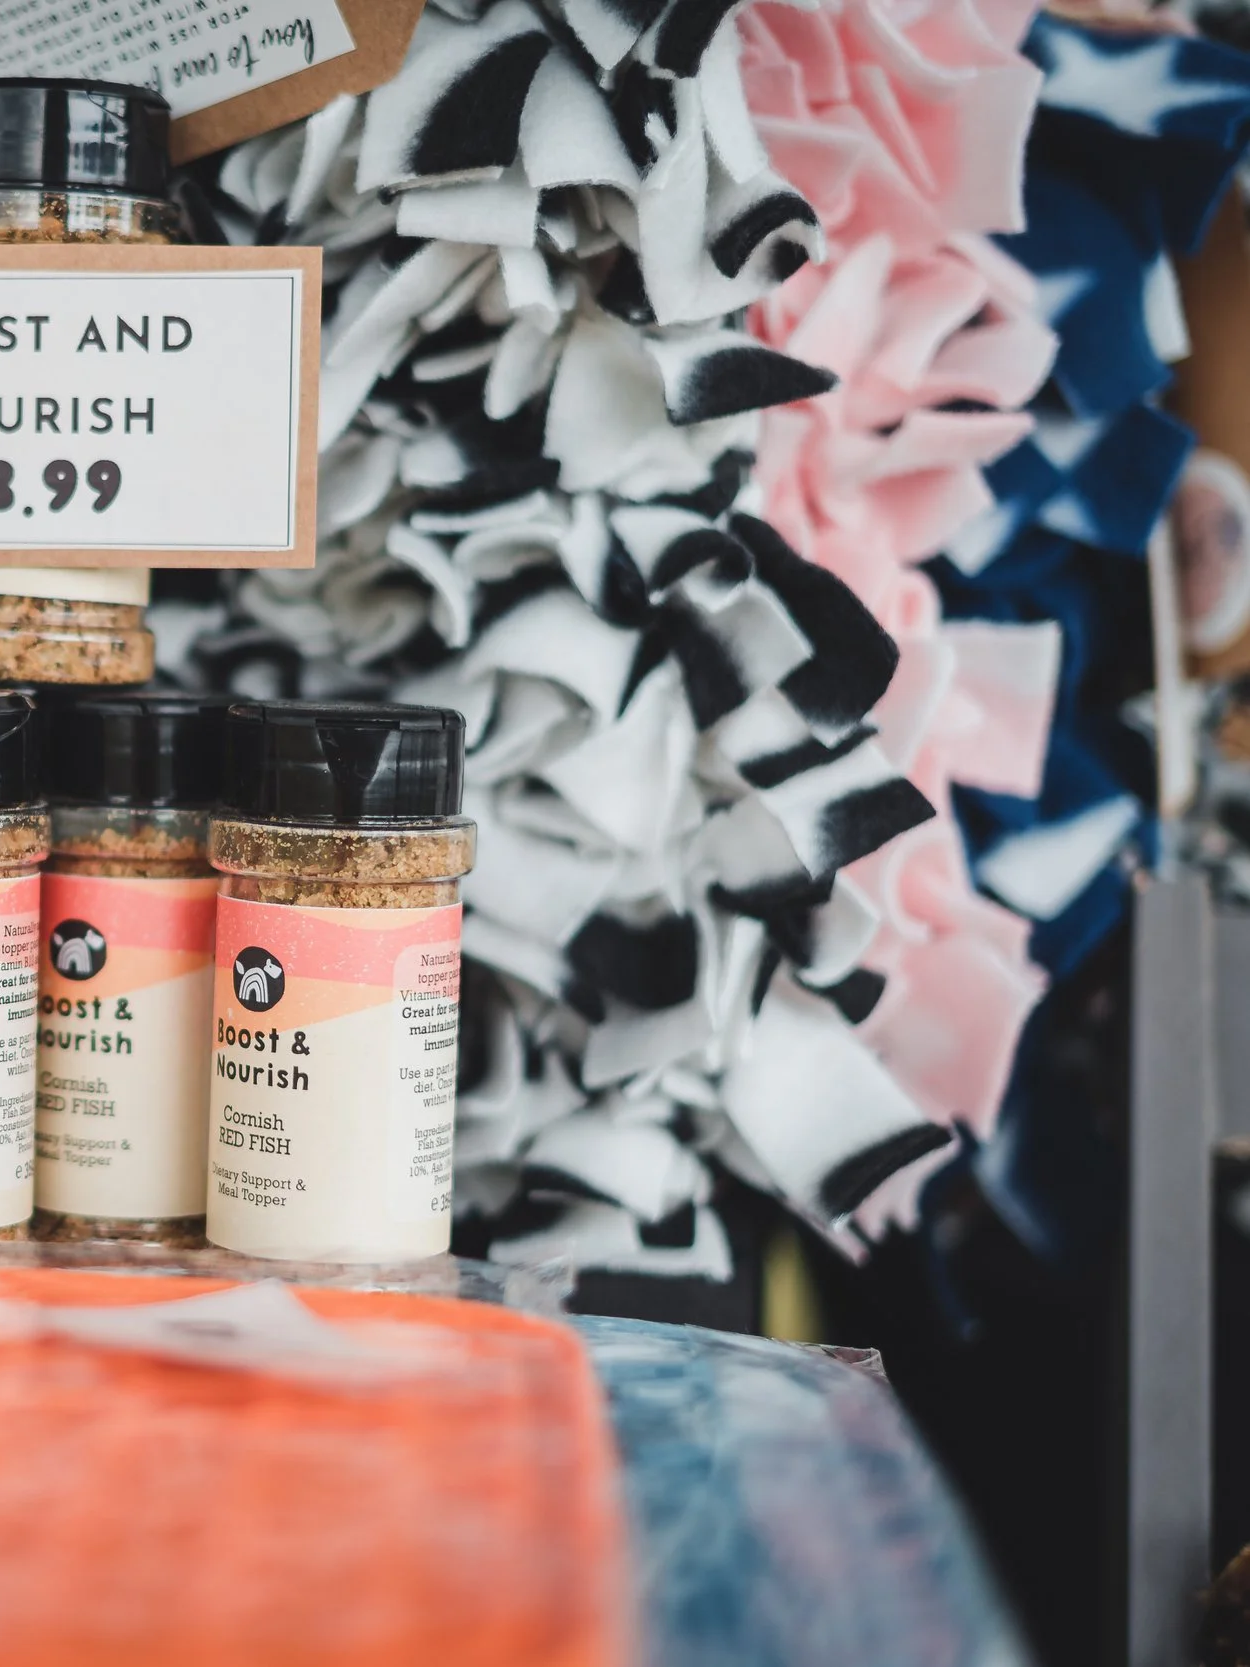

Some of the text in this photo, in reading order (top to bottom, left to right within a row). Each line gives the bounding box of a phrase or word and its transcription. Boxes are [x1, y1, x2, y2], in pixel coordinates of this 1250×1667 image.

[261, 19, 314, 63] how
[227, 35, 258, 75] to
[76, 315, 193, 353] AND
[1, 943, 30, 957] topper
[418, 971, 448, 986] topper
[400, 988, 441, 1002] Vitamin
[37, 995, 133, 1020] oost &
[402, 1006, 434, 1019] Great
[436, 1004, 447, 1016] for
[8, 1038, 17, 1047] as
[217, 1017, 311, 1056] Boost &
[40, 1071, 109, 1094] Cornish
[216, 1053, 310, 1091] Nourish
[399, 1068, 421, 1080] Use
[424, 1068, 434, 1078] as
[414, 1081, 436, 1094] diet.
[71, 1098, 116, 1117] FISH
[224, 1105, 285, 1132] Cornish
[219, 1126, 291, 1156] RED FISH
[241, 1171, 291, 1191] Support
[295, 1178, 307, 1192] &
[218, 1181, 287, 1207] Meal Topper
